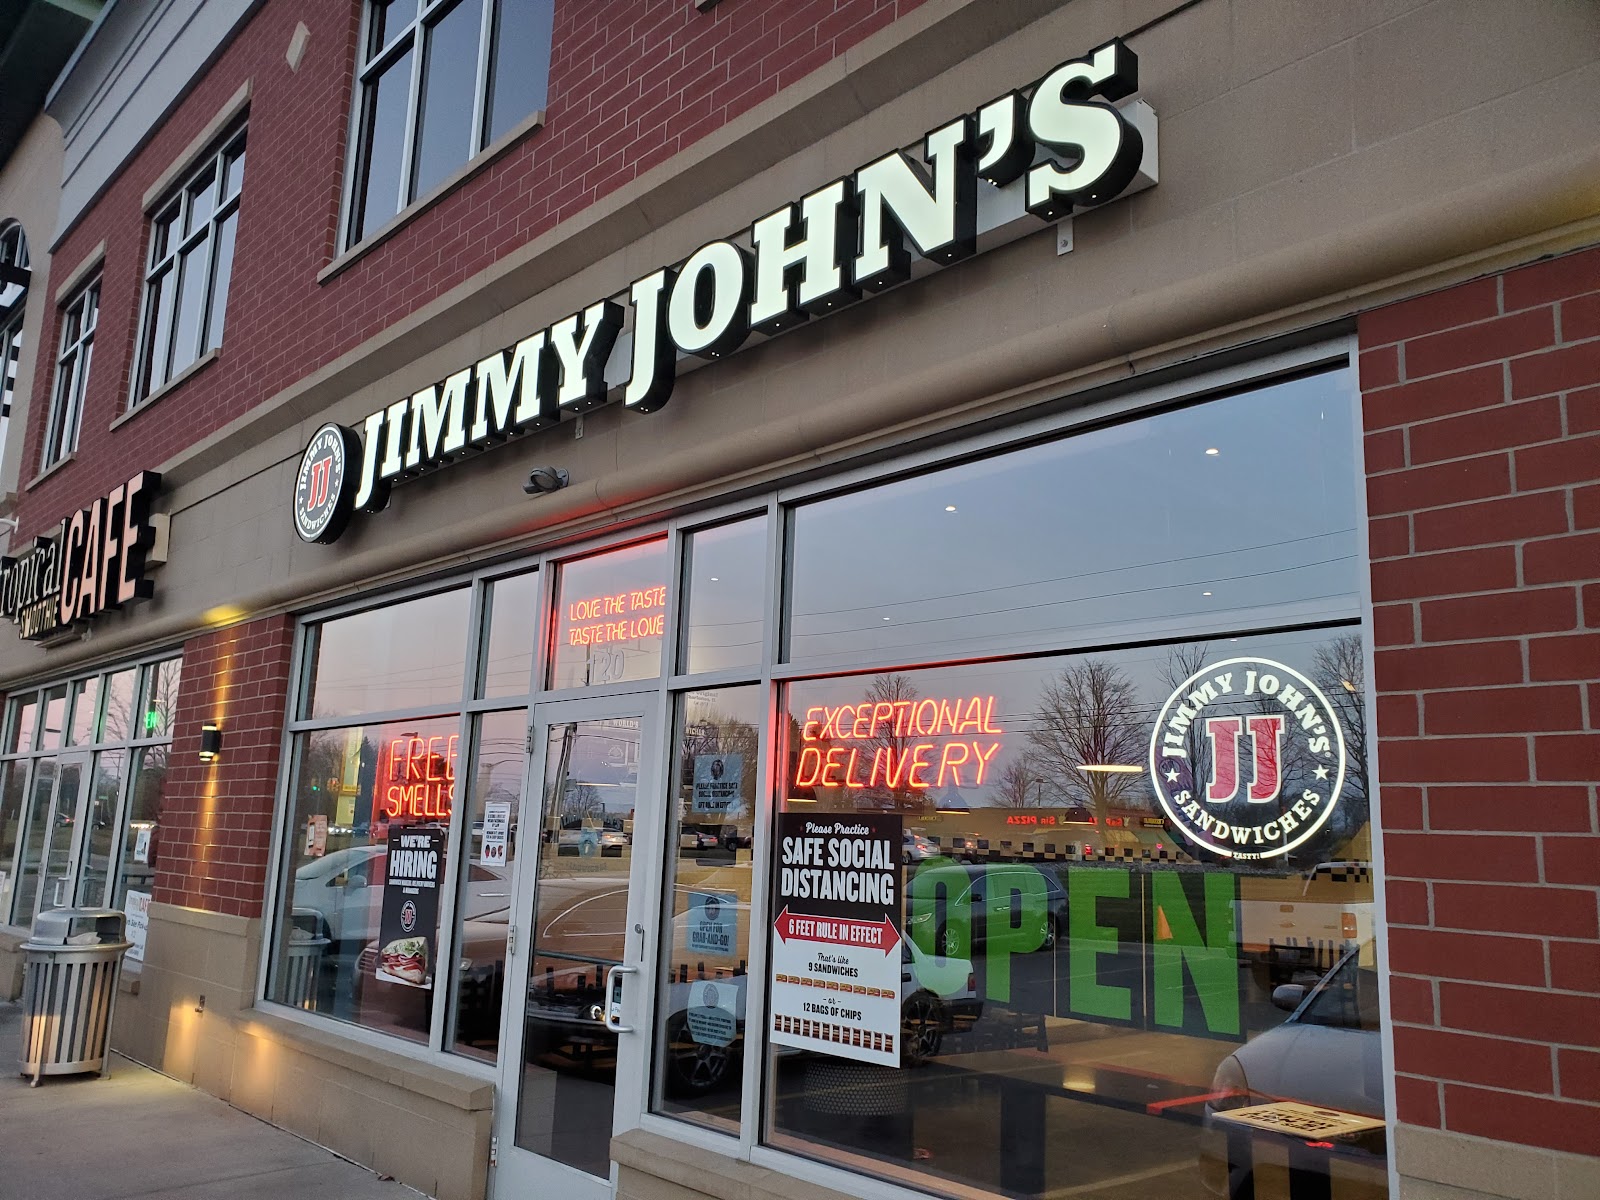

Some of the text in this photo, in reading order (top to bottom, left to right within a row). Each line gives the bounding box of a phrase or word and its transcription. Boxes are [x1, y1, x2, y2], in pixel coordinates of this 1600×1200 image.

[354, 42, 1124, 508] JIMMY JOHN'S
[300, 437, 322, 490] JIMMY
[307, 455, 332, 512] JJ
[300, 493, 335, 530] SANDWICHES
[61, 470, 145, 625] CAFE
[19, 594, 60, 640] SMOOTHIE
[570, 587, 666, 621] LOVE THE TASTE
[570, 615, 665, 646] TASTE THE LOVE
[803, 696, 1002, 741] EXCEPTIONAL
[1162, 671, 1330, 758] JIMMY JOHN'S
[389, 735, 459, 780] FREE
[796, 741, 999, 788] DELIVERY
[1205, 714, 1285, 803] JJ
[806, 821, 869, 835] Please Practice
[1174, 788, 1320, 845] SANDWICHES
[401, 835, 431, 848] WE'RE
[782, 837, 895, 870] SAFE SOCIAL
[389, 850, 437, 879] HIRING
[781, 867, 894, 906] DISTANCING
[788, 918, 883, 945] 6 FEET RULE IN EFFECT
[912, 855, 1240, 1036] OPEN
[808, 962, 858, 978] 9 SANDWICHES
[817, 953, 849, 965] That's like
[803, 1002, 862, 1021] 12 BAGS OF CHIPS
